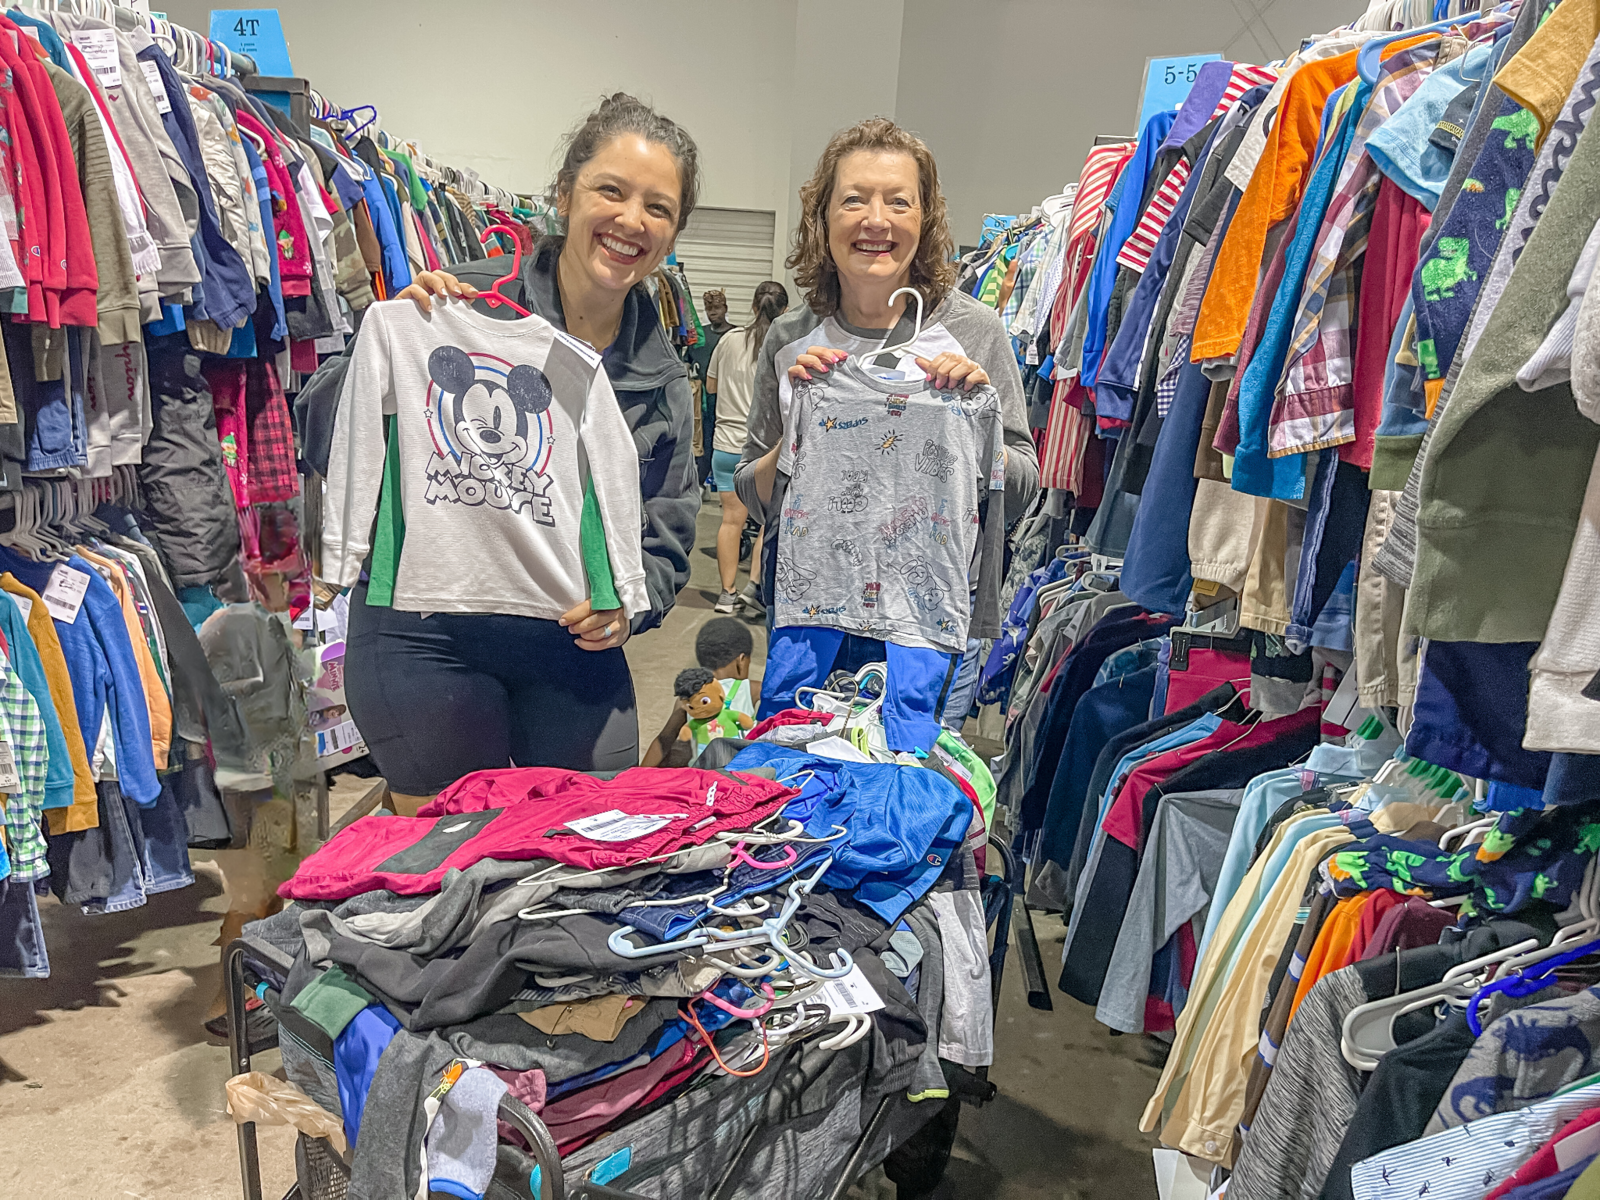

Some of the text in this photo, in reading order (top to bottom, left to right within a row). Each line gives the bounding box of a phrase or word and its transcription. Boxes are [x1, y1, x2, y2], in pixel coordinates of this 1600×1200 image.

[233, 16, 260, 37] 4T
[914, 452, 955, 483] VIBES
[327, 661, 341, 692] MINNIE
